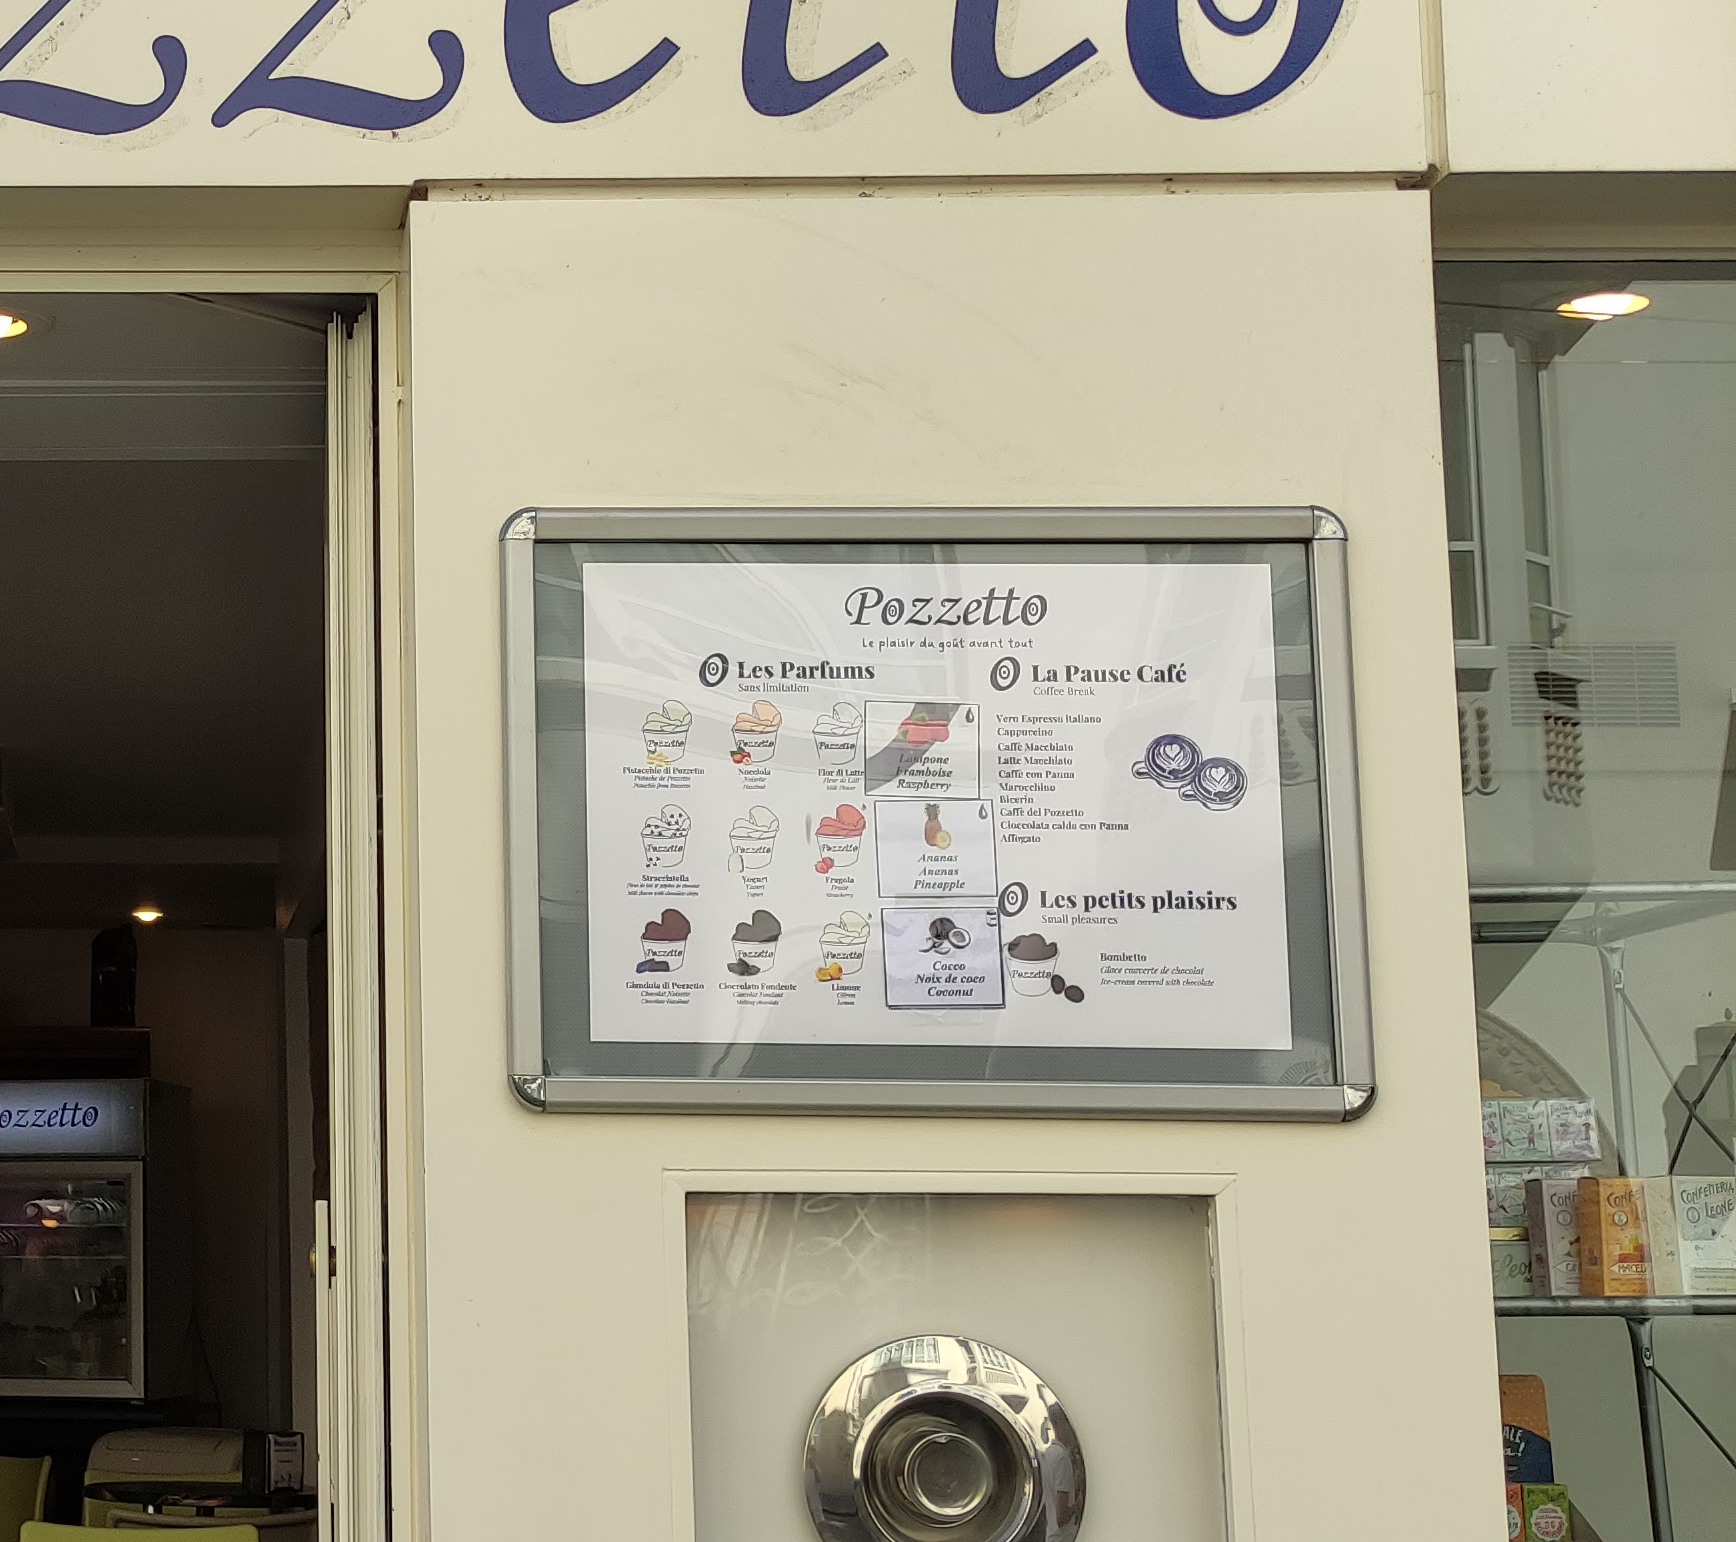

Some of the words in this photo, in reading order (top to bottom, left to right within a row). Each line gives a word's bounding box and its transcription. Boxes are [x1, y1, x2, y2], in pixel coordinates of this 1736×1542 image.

[844, 586, 1049, 627] Pozzetto
[862, 637, 875, 649] Le
[878, 636, 916, 653] plaisir
[919, 637, 935, 649] du
[968, 639, 1004, 649] avant
[1008, 638, 1034, 649] tout
[737, 660, 774, 680] Les
[780, 660, 876, 680] Parfums
[1031, 664, 1059, 683] La
[1064, 664, 1132, 684] Pause
[1136, 662, 1188, 684] Café
[737, 682, 761, 693] Sans
[762, 682, 810, 694] limitation
[1033, 686, 1065, 697] Coffee
[1067, 686, 1096, 697] Break
[896, 778, 953, 793] Raspberry
[917, 853, 959, 863] Ananas
[918, 866, 959, 877] Ananas
[913, 879, 966, 892] Pineapple
[1039, 890, 1078, 910] Les
[1083, 889, 1146, 913] petits
[1151, 889, 1238, 914] plaisirs
[1041, 914, 1069, 925] Small
[1071, 914, 1119, 926] pleasures
[932, 960, 967, 972] Cocco
[914, 973, 943, 985] Noix
[944, 972, 959, 985] de
[960, 975, 986, 984] coco
[927, 986, 975, 998] Coconut
[1704, 1198, 1735, 1219] LEONE
